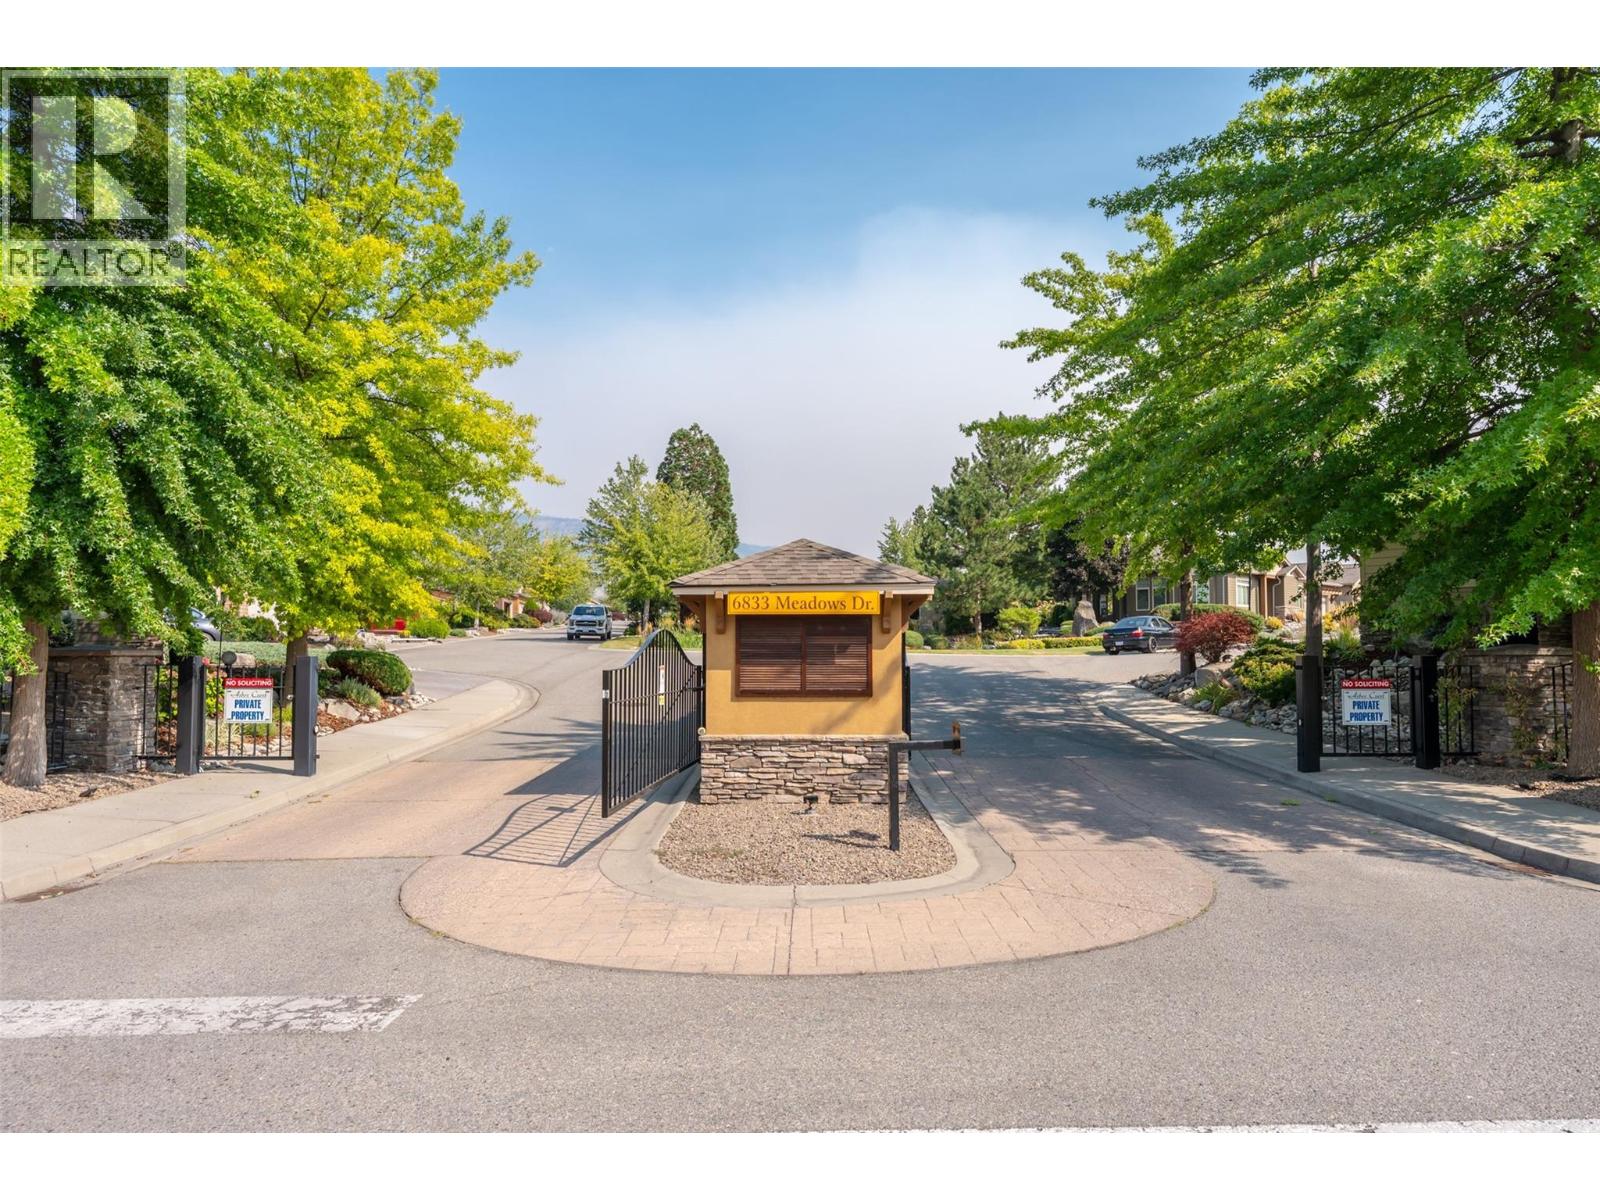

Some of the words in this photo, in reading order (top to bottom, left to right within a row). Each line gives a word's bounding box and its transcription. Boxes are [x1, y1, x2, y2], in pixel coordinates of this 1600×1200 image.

[732, 595, 770, 610] 6833
[775, 595, 847, 610] Meadows
[851, 596, 875, 610] Dr.
[234, 699, 261, 708] PRIVATE
[1352, 700, 1379, 710] PRIVATE
[231, 711, 264, 720] PROPERTY
[1350, 712, 1383, 721] PROPERTY
